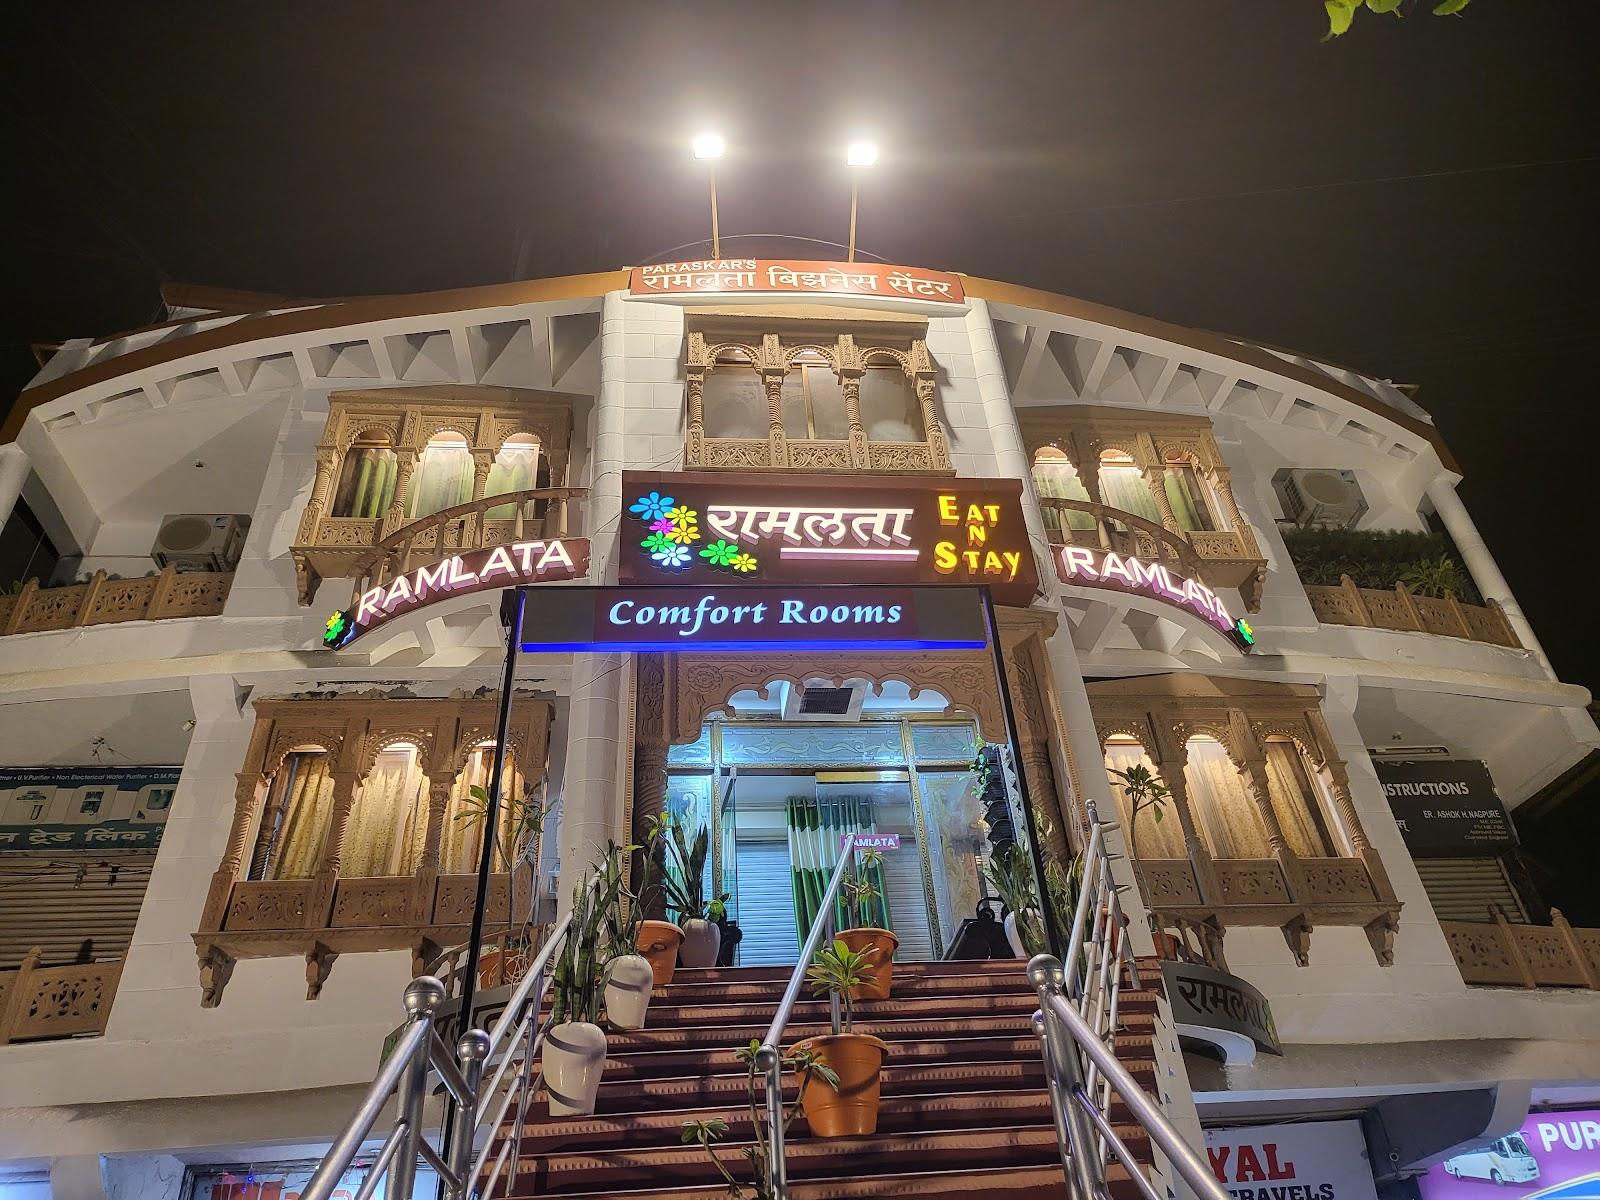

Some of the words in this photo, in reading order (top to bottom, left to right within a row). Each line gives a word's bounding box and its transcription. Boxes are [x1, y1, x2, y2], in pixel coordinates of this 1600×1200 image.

[642, 258, 757, 274] PARASKAR'S
[642, 271, 757, 290] रामलता
[766, 265, 878, 291] बिझनेस
[887, 271, 954, 299] सेंटर
[706, 505, 914, 546] रामलता
[938, 495, 1000, 526] EAT
[969, 525, 986, 546] N
[356, 540, 576, 627] RAMLATA
[1061, 546, 1236, 632] RAMLATA
[609, 595, 768, 636] Comfort
[779, 599, 902, 624] Rooms
[84, 827, 150, 842] लिंक
[844, 838, 896, 847] AMLATA
